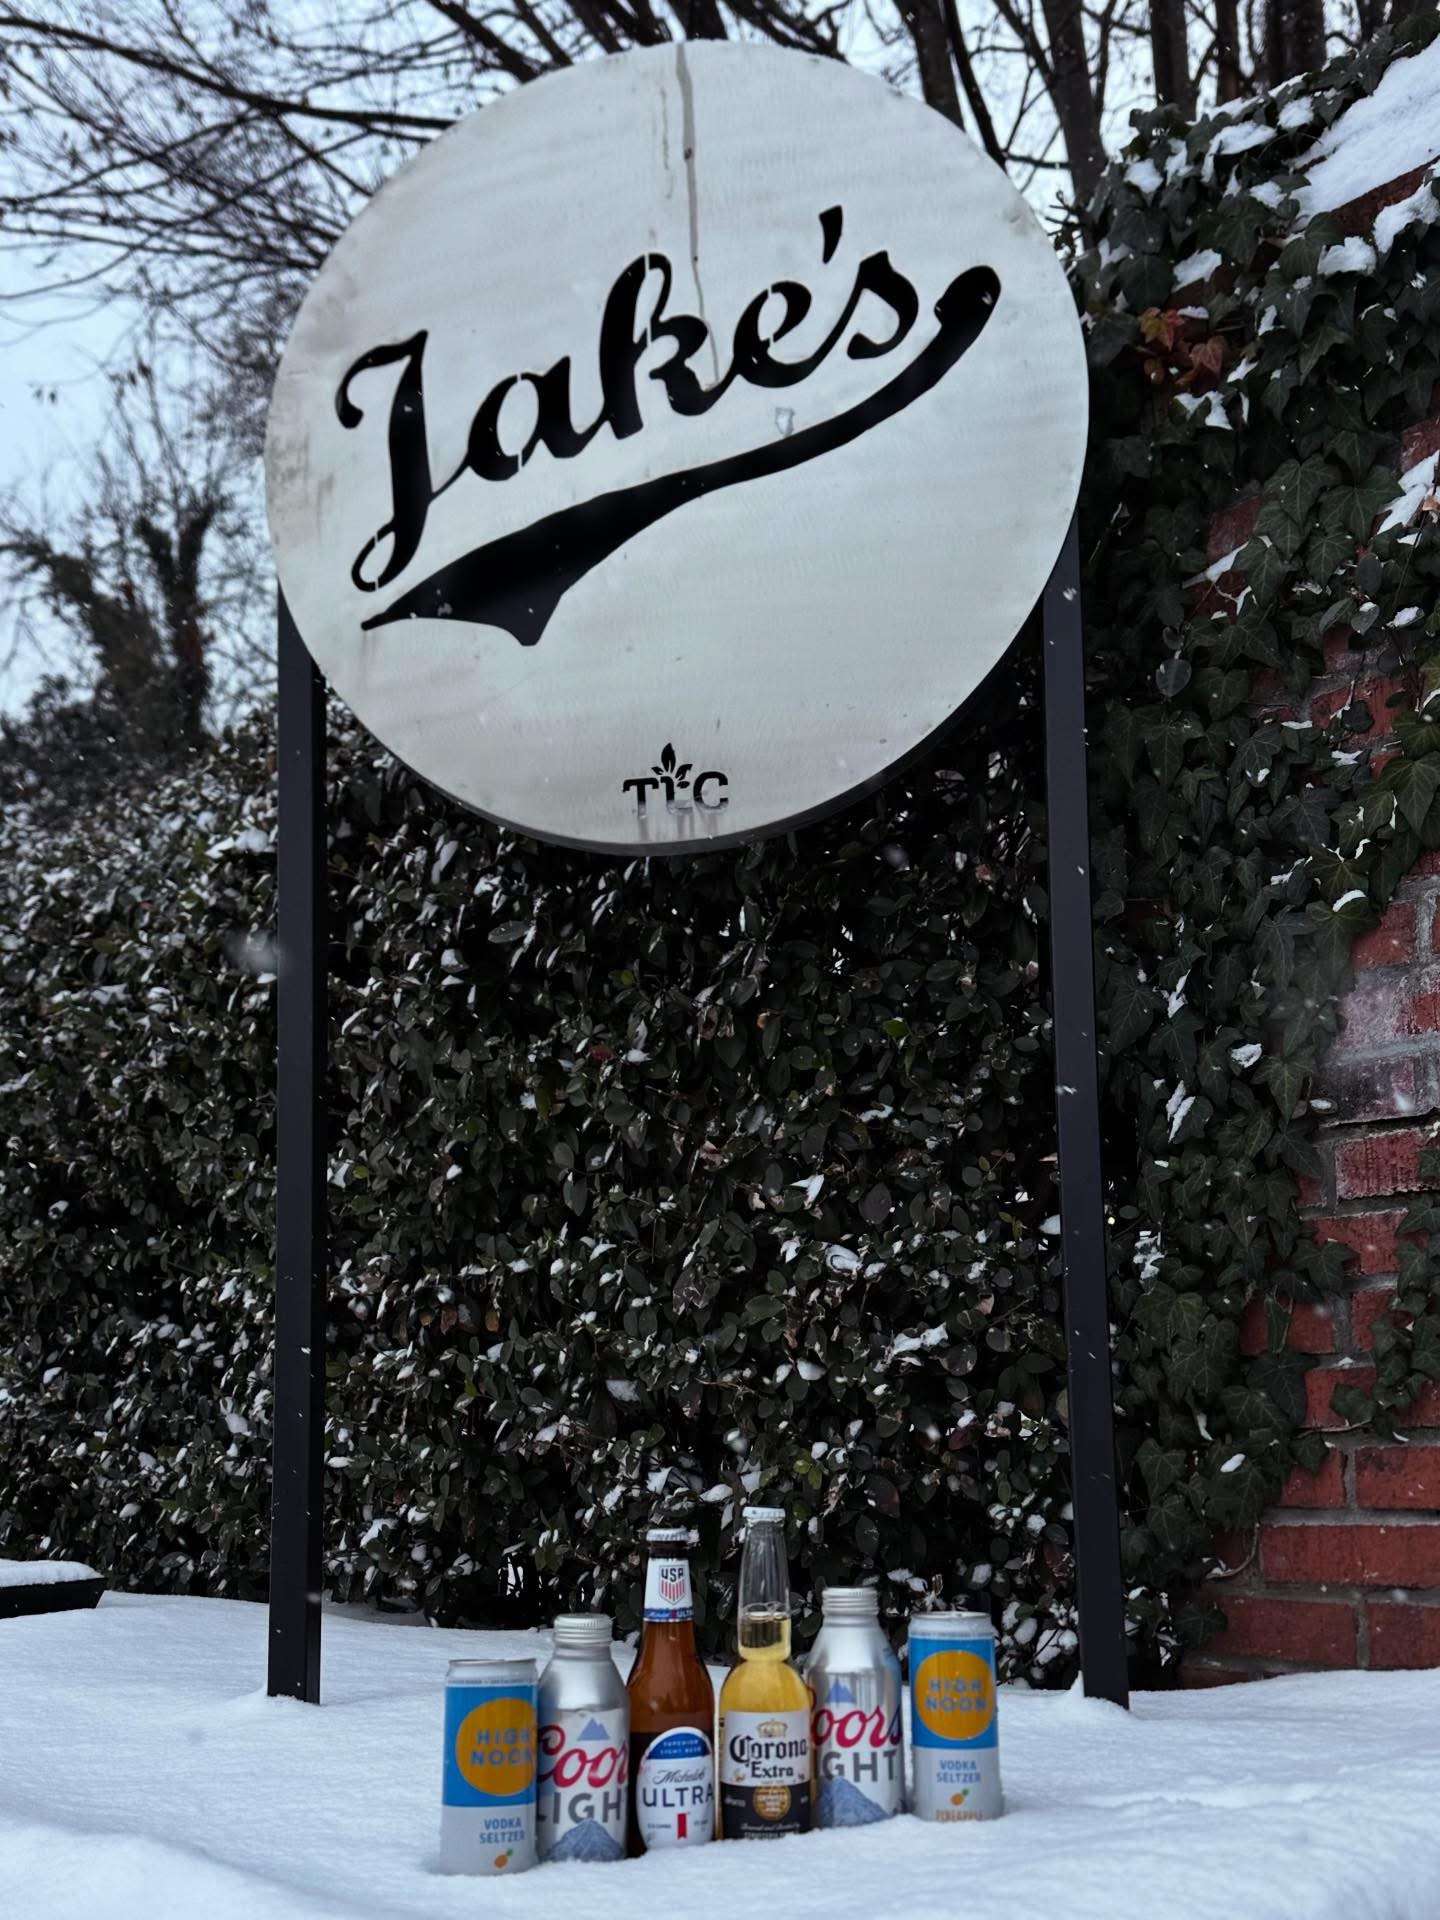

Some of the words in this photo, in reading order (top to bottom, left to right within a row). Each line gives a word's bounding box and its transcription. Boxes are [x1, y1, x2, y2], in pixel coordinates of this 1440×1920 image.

[335, 205, 919, 592] Jake's
[623, 771, 728, 816] TLC
[661, 1567, 684, 1582] USA
[928, 1678, 983, 1694] HIGH
[925, 1697, 987, 1712] NOON
[729, 1734, 808, 1767] Corona
[751, 1761, 795, 1778] Extra
[939, 1760, 977, 1771] VODKA
[936, 1772, 981, 1784] SELTZER
[484, 1817, 522, 1830] VODKA
[479, 1831, 525, 1844] SELTZER
